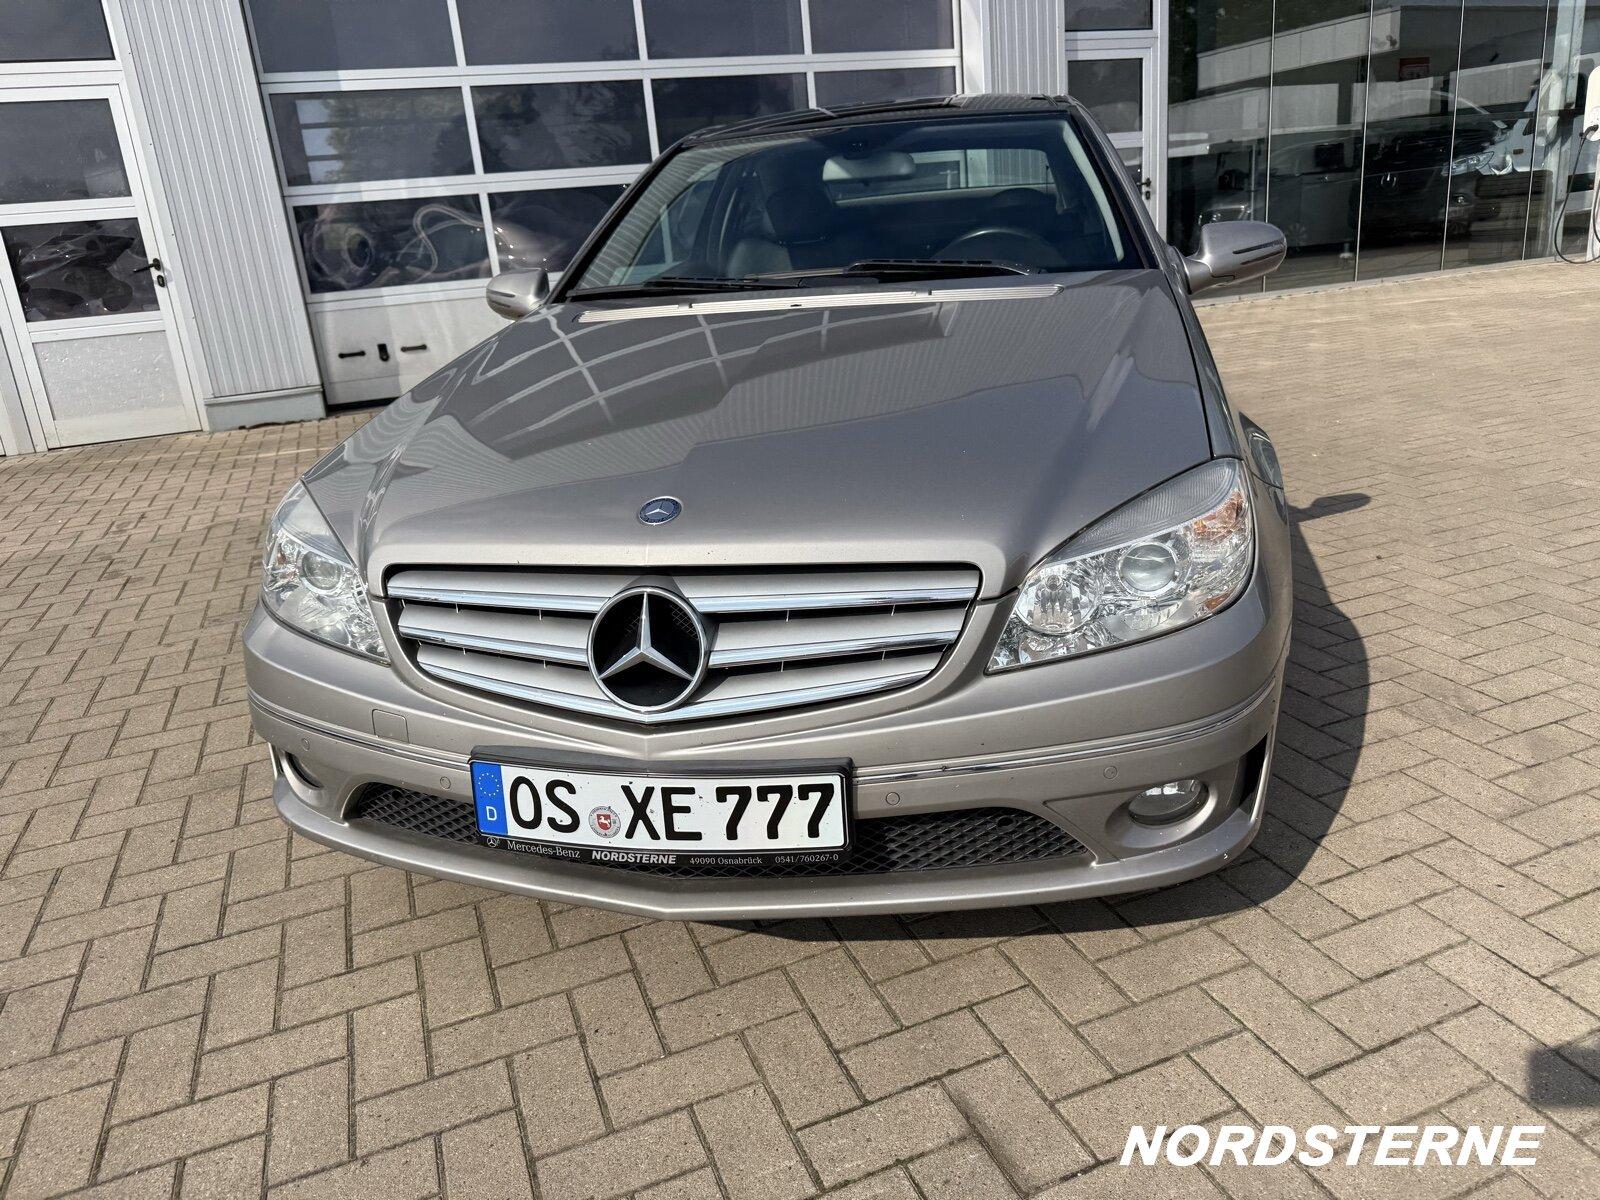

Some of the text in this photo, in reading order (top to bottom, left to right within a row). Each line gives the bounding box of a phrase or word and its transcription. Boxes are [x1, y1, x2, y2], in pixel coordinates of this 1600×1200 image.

[485, 805, 498, 821] D
[509, 776, 580, 833] OS
[620, 784, 703, 841] XE
[715, 783, 835, 841] 777
[507, 840, 581, 859] Mercedes-Benz
[591, 850, 677, 865] NORDSTERNE
[689, 856, 763, 865] 49090 Osnabrück
[774, 853, 839, 864] 0541/760267-0
